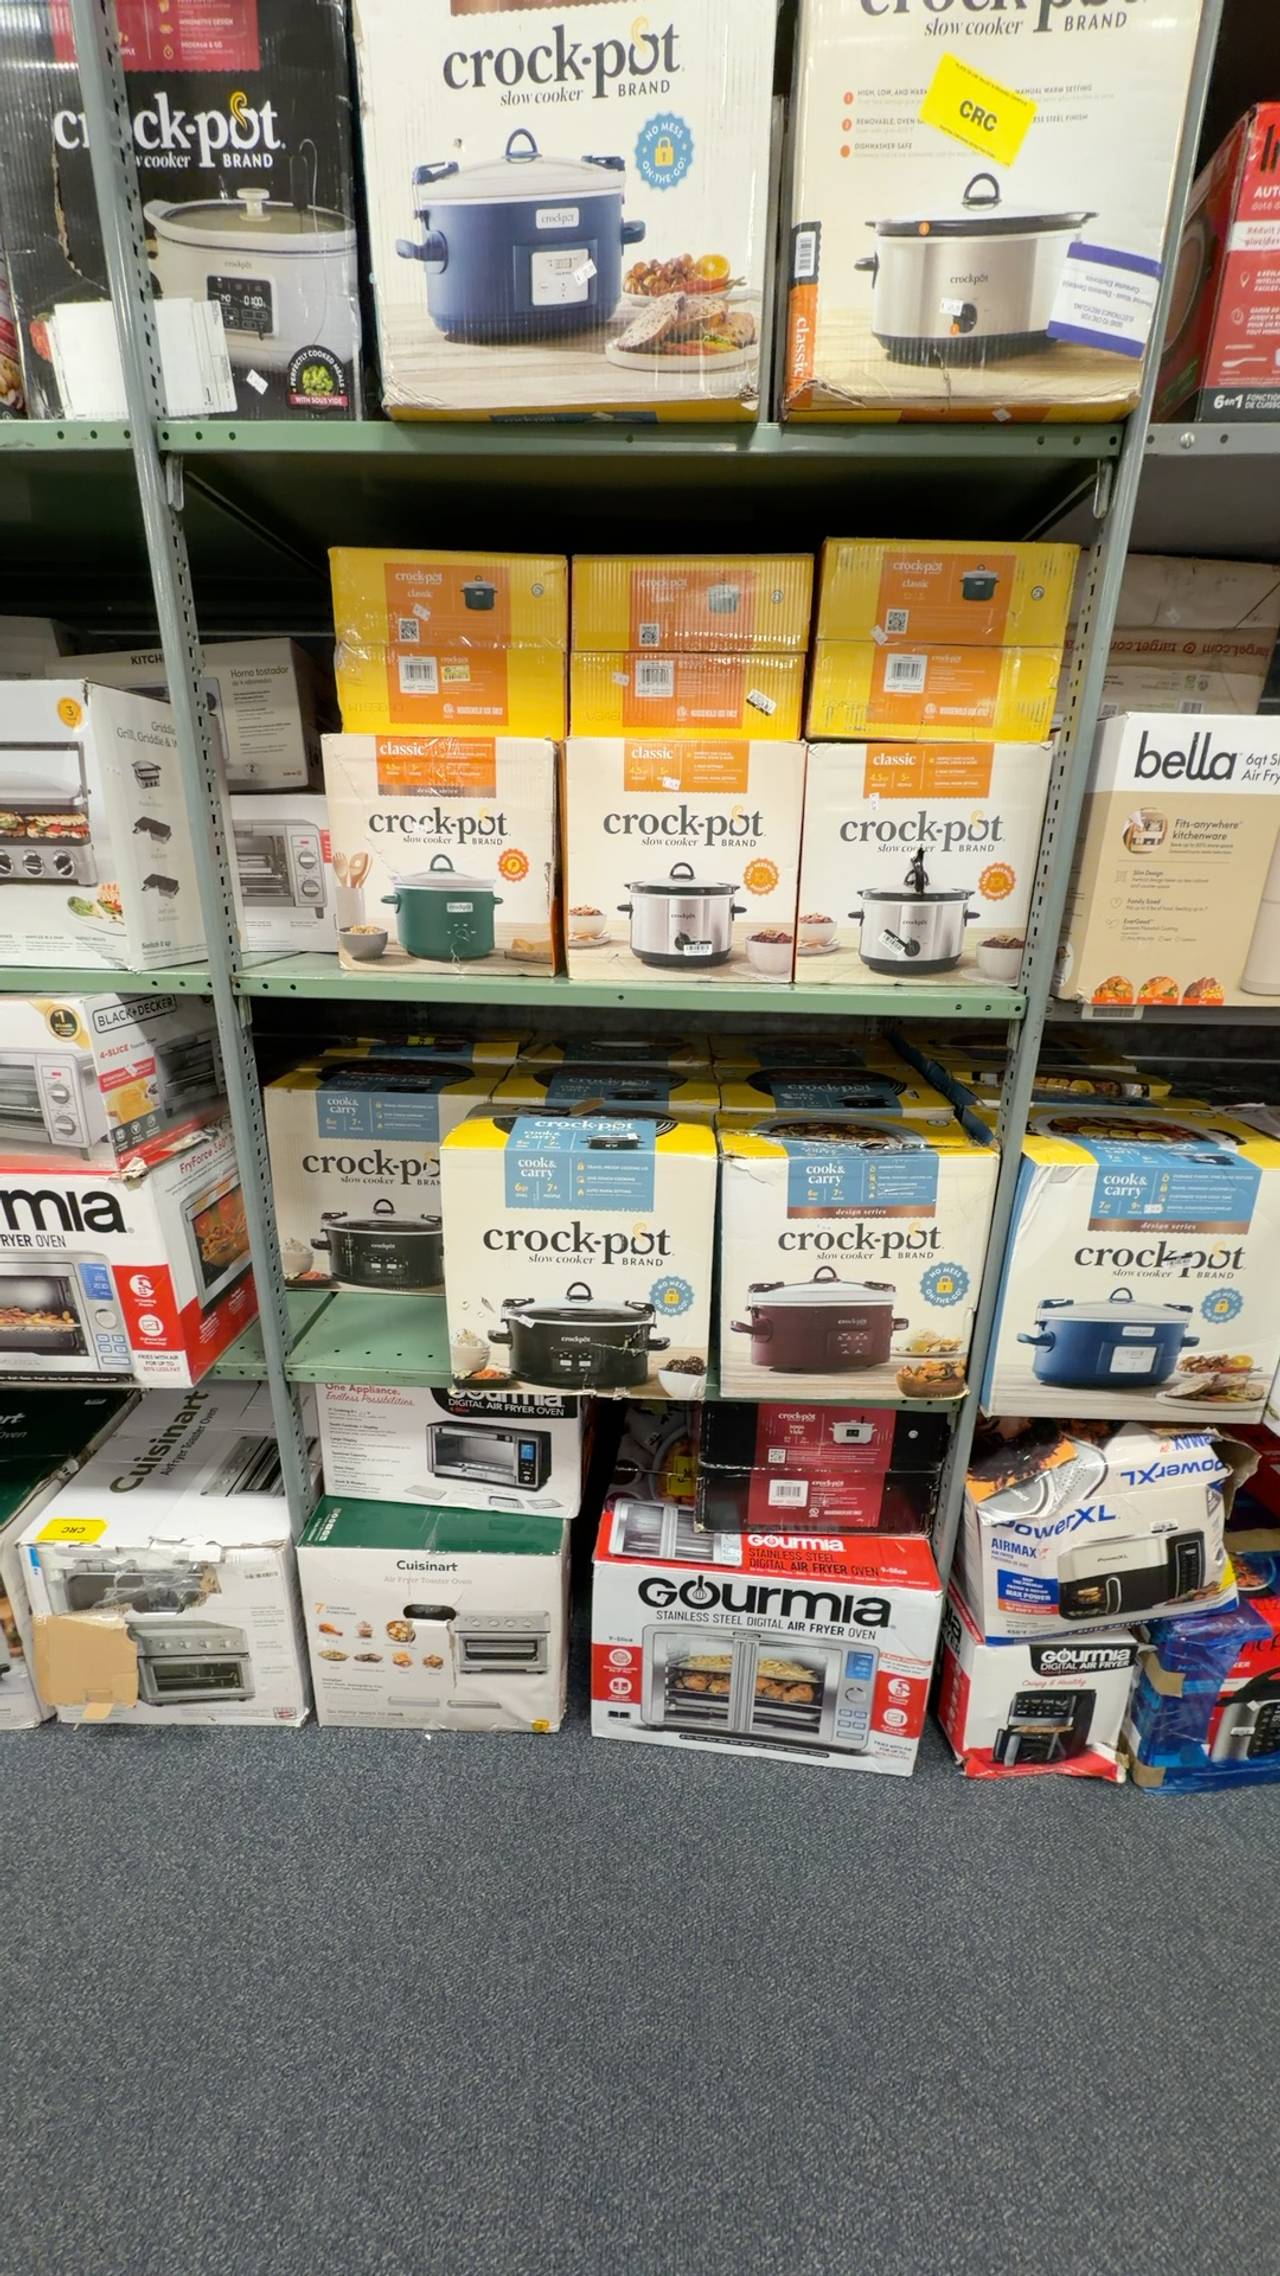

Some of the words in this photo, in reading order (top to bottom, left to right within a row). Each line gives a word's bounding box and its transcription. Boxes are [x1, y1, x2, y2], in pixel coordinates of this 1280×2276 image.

[924, 17, 959, 36] slow
[966, 17, 1023, 36] cooker
[1064, 11, 1127, 32] BRAND
[617, 79, 671, 98] BRAND
[500, 89, 533, 106] slow
[535, 87, 584, 105] cooker
[958, 99, 999, 133] CRC
[645, 125, 659, 142] NO
[661, 122, 684, 139] MESS
[144, 152, 191, 169] cooker
[223, 153, 273, 169] BRAND
[790, 316, 809, 387] classic
[307, 350, 335, 365] COOKED
[333, 362, 345, 387] MEALS
[902, 578, 929, 589] classic
[130, 654, 165, 666] KITCH
[65, 705, 74, 717] 3
[380, 741, 424, 756] classic
[631, 746, 673, 761] classic
[1135, 730, 1238, 780] bella
[872, 752, 917, 766] classic
[1246, 753, 1268, 766] 6qt
[1174, 819, 1240, 831] Fits-anywhere
[403, 836, 422, 844] slow
[423, 836, 452, 844] cooker
[472, 837, 503, 846] BRAND
[642, 837, 664, 847] slow
[665, 837, 699, 847] cooker
[1172, 831, 1228, 841] kitchenware
[721, 839, 757, 848] BRAND
[877, 842, 900, 853] slow
[958, 844, 995, 853] BRAND
[54, 1011, 65, 1023] 1
[100, 1044, 129, 1058] 4-SLICE
[329, 1106, 356, 1116] carry
[302, 1149, 440, 1185] crock-po
[340, 1176, 360, 1185] slow
[362, 1176, 394, 1185] cooker
[520, 1169, 554, 1181] carry
[808, 1174, 843, 1186] carry
[1104, 1186, 1142, 1199] carry
[835, 1208, 862, 1217] design
[863, 1208, 887, 1216] series
[1140, 1222, 1169, 1231] design
[1171, 1222, 1197, 1231] series
[0, 1234, 33, 1247] RYER
[37, 1234, 67, 1248] OVEN
[528, 1253, 553, 1264] slow
[555, 1254, 596, 1265] cooker
[621, 1257, 664, 1267] BRAND
[816, 1251, 839, 1261] slow
[840, 1251, 874, 1260] cooker
[898, 1251, 934, 1260] BRAND
[1112, 1269, 1135, 1279] slow
[1136, 1269, 1172, 1279] cooker
[1196, 1271, 1235, 1280] BRAND
[325, 1383, 345, 1391] One
[349, 1385, 401, 1396] Appliance.
[448, 1398, 485, 1409] DIGITAL
[486, 1402, 503, 1411] AIR
[504, 1404, 535, 1414] FRYER
[536, 1407, 565, 1417] OVEN
[110, 1390, 209, 1494] Cuisinart
[747, 1534, 845, 1552] Gourmia
[991, 1537, 1037, 1559] AIRMAX
[749, 1549, 802, 1561] STAINLESS
[806, 1551, 835, 1563] STEEL
[396, 1559, 458, 1572] Cuisinart
[750, 1558, 786, 1570] DIGITAL
[791, 1561, 808, 1572] AIR
[812, 1562, 848, 1575] FRYER
[851, 1565, 879, 1577] OVEN
[397, 1576, 419, 1585] Fryer
[421, 1577, 450, 1585] Toaster
[314, 1602, 325, 1614] 7
[638, 1575, 892, 1629] Gourmia
[656, 1610, 710, 1623] STAINLESS
[713, 1614, 743, 1626] STEEL
[746, 1616, 784, 1630] DIGITAL
[787, 1620, 806, 1632] AIR
[809, 1622, 845, 1637] FRYER
[848, 1627, 877, 1641] OVEN
[1040, 1648, 1131, 1664] Gourmia
[1040, 1661, 1077, 1671] DIGITAL
[1079, 1661, 1097, 1670] AIR
[1099, 1660, 1129, 1669] FRYER
